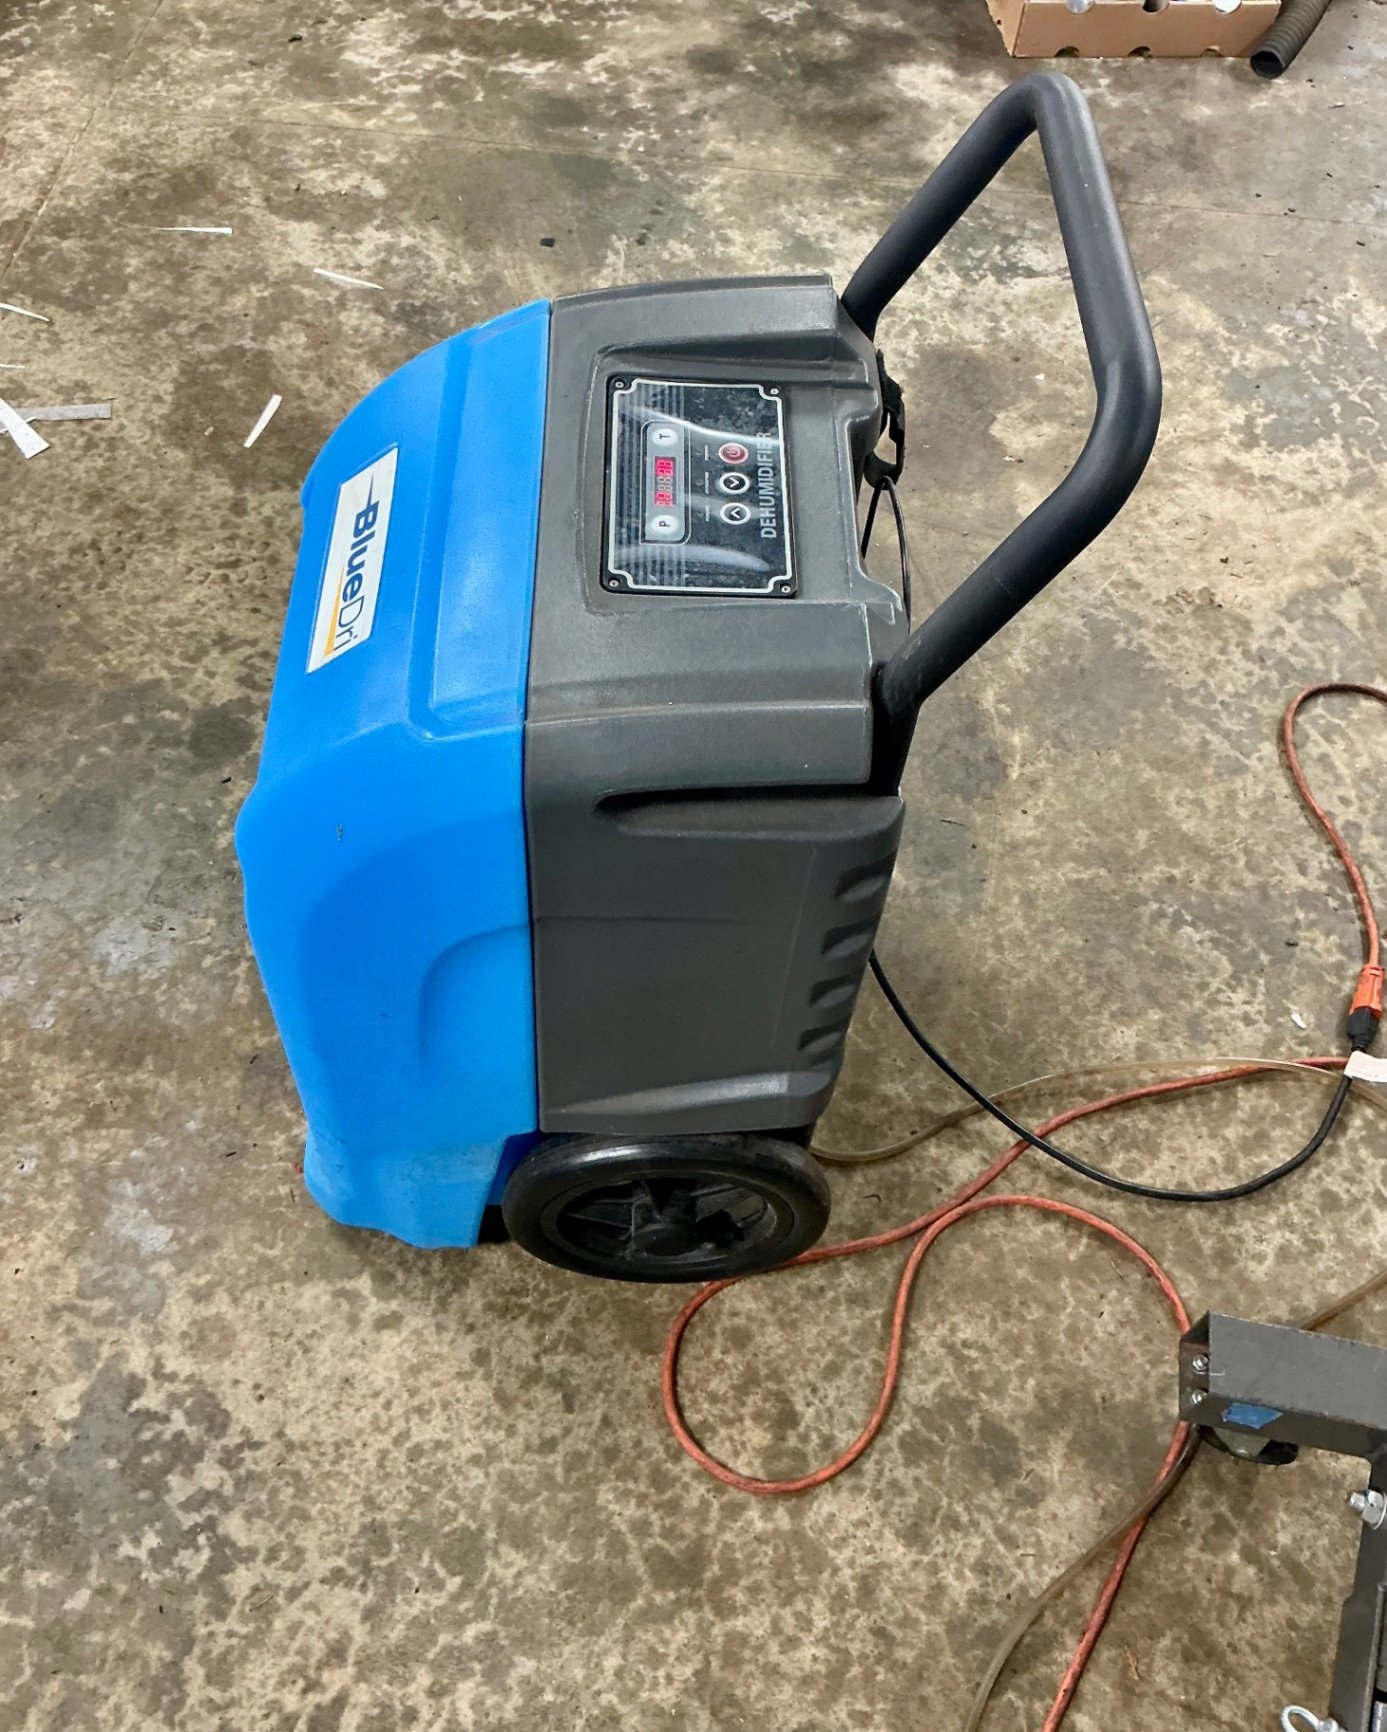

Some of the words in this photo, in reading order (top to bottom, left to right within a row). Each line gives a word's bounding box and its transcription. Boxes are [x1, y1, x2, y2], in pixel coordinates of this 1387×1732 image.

[659, 520, 671, 528] P
[757, 431, 778, 539] DEHUMIDIFIER
[333, 500, 380, 651] BlueDri
